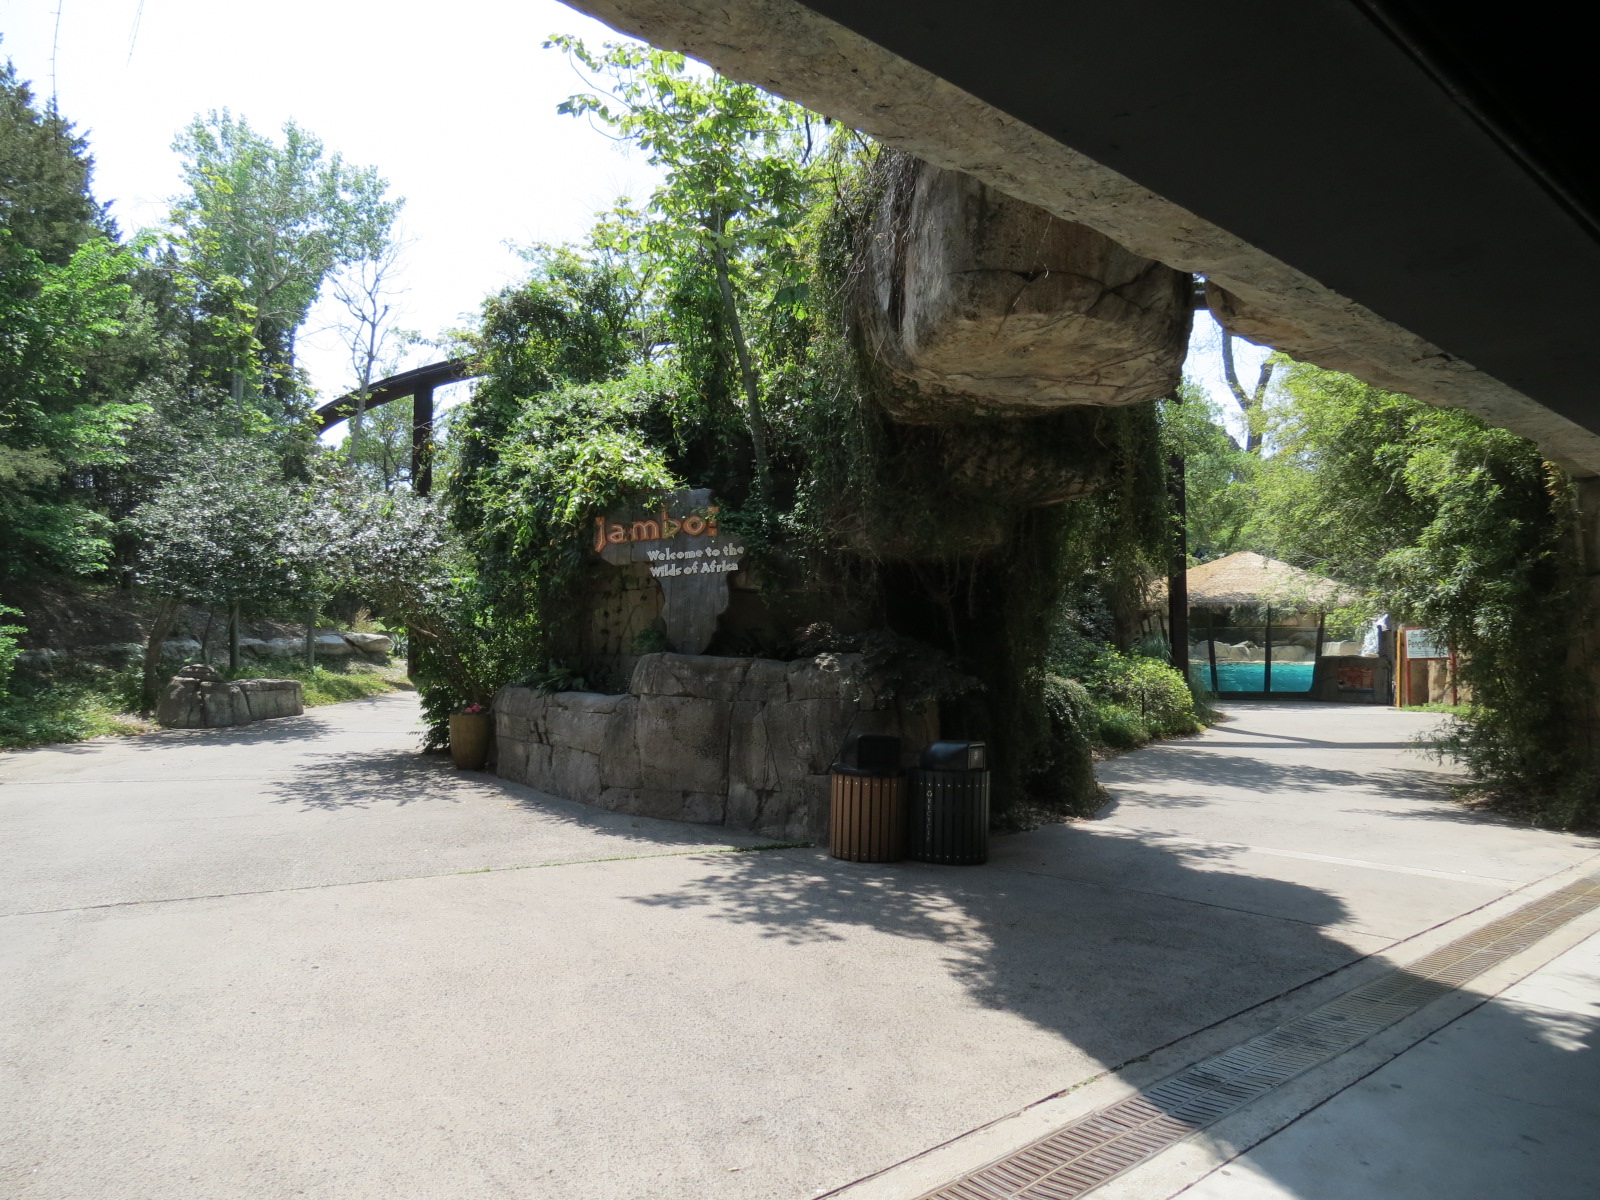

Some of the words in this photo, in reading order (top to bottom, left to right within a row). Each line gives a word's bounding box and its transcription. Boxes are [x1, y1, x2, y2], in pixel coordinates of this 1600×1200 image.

[646, 547, 704, 562] Welcome
[706, 546, 721, 557] to
[723, 542, 745, 555] the
[650, 563, 682, 578] Wilds
[684, 561, 698, 575] of
[700, 560, 739, 573] Africa
